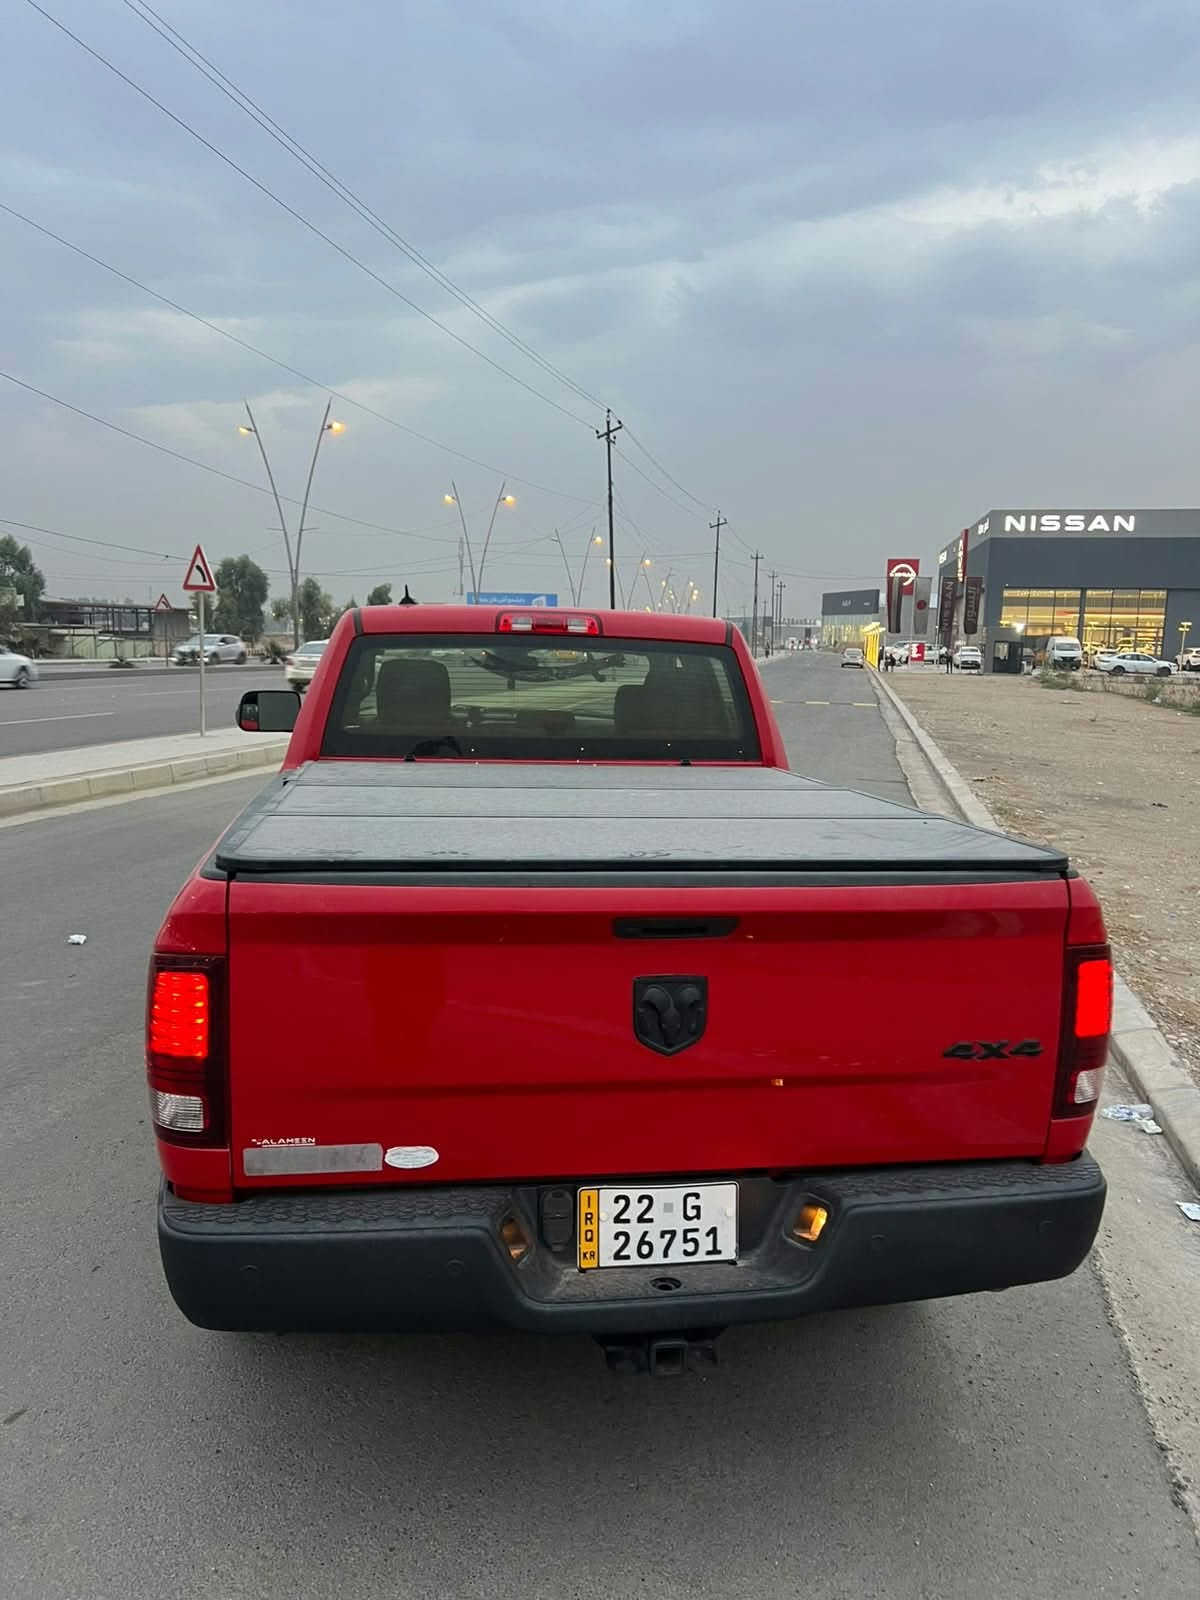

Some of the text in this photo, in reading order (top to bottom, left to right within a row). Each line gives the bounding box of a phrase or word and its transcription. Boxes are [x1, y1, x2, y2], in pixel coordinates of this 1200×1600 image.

[1004, 514, 1136, 532] NISSAN
[613, 1192, 702, 1224] 22 G
[582, 1250, 596, 1261] KR
[612, 1226, 722, 1261] 26751
